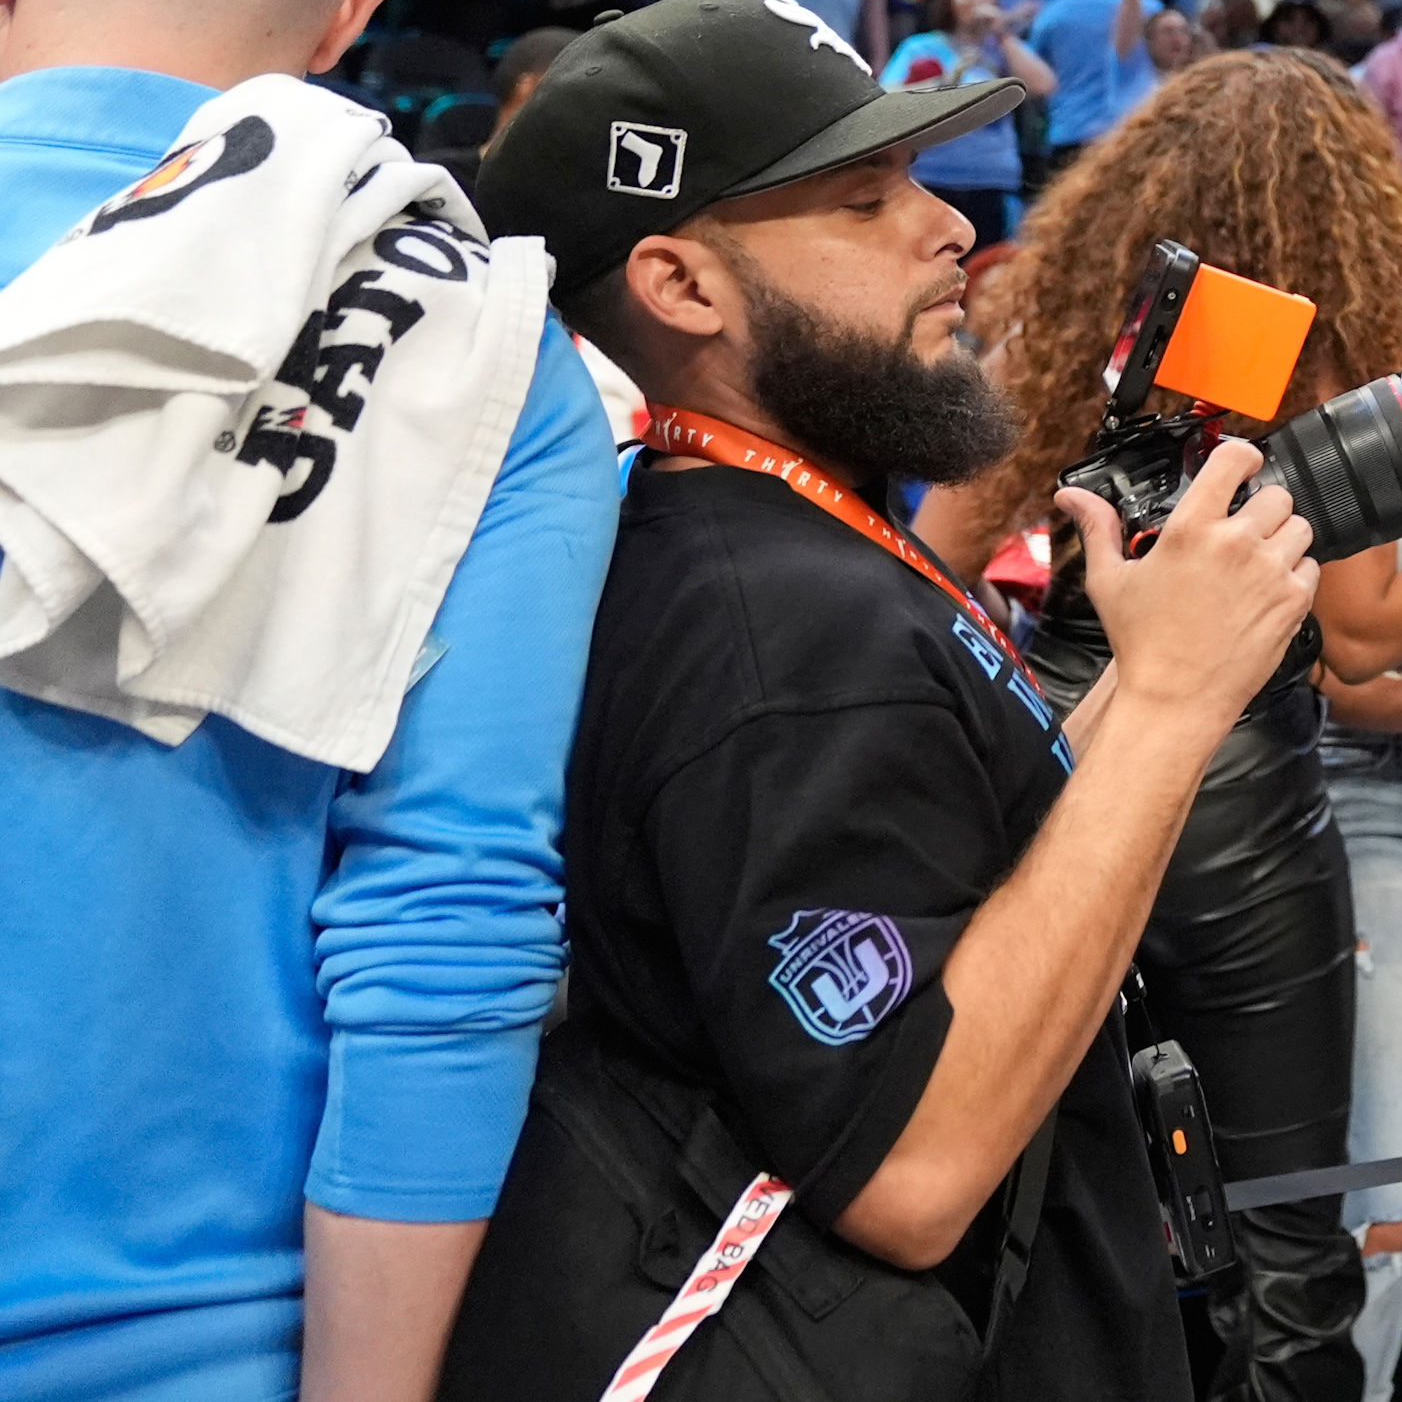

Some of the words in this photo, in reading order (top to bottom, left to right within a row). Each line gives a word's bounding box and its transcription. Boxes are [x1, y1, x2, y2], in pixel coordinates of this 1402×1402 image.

[655, 412, 714, 450] HIRTY
[743, 450, 843, 503] THIRTY
[736, 1175, 780, 1235] VED
[696, 1241, 744, 1293] BAG
